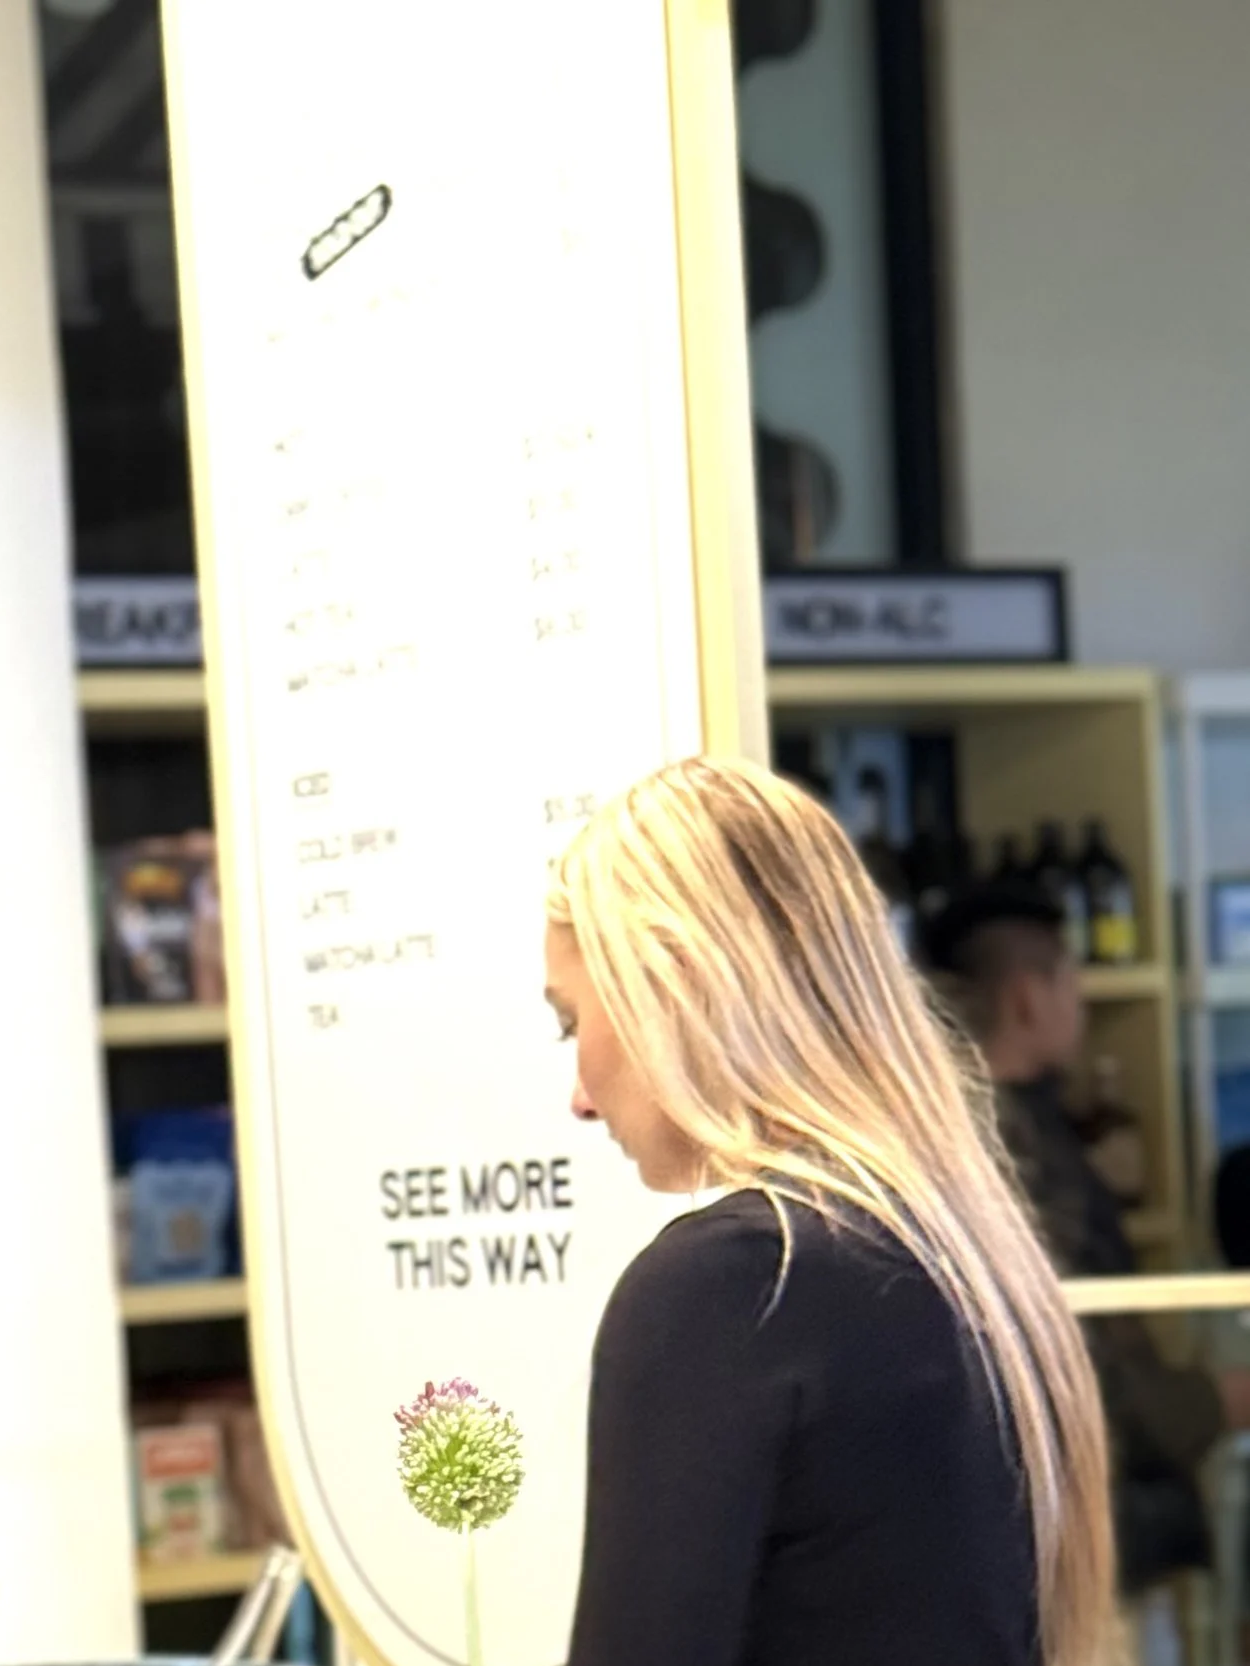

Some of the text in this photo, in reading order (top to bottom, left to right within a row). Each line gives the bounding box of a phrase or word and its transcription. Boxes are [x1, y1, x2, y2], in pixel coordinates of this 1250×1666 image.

[380, 1157, 575, 1221] SEE MORE
[386, 1231, 572, 1290] THIS WAY
